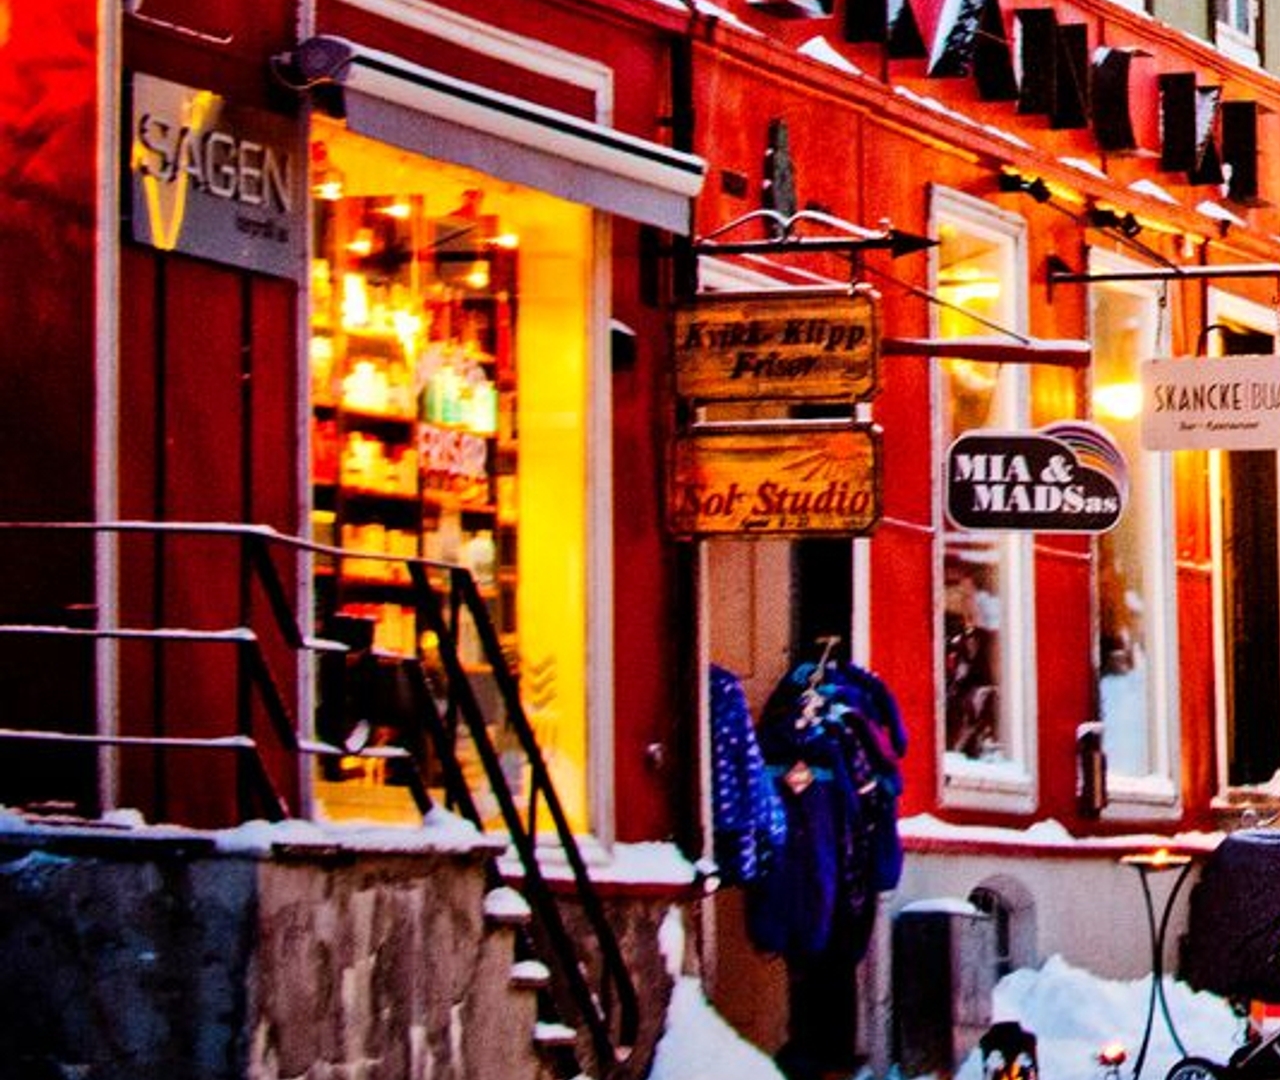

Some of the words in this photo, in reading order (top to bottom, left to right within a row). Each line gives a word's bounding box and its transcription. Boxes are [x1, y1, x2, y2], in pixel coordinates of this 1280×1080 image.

[139, 114, 294, 214] SAGEN
[1154, 382, 1242, 413] SKANCKE
[953, 454, 1032, 483] MIA
[1040, 454, 1074, 483] &
[972, 483, 1118, 514] MADSas
